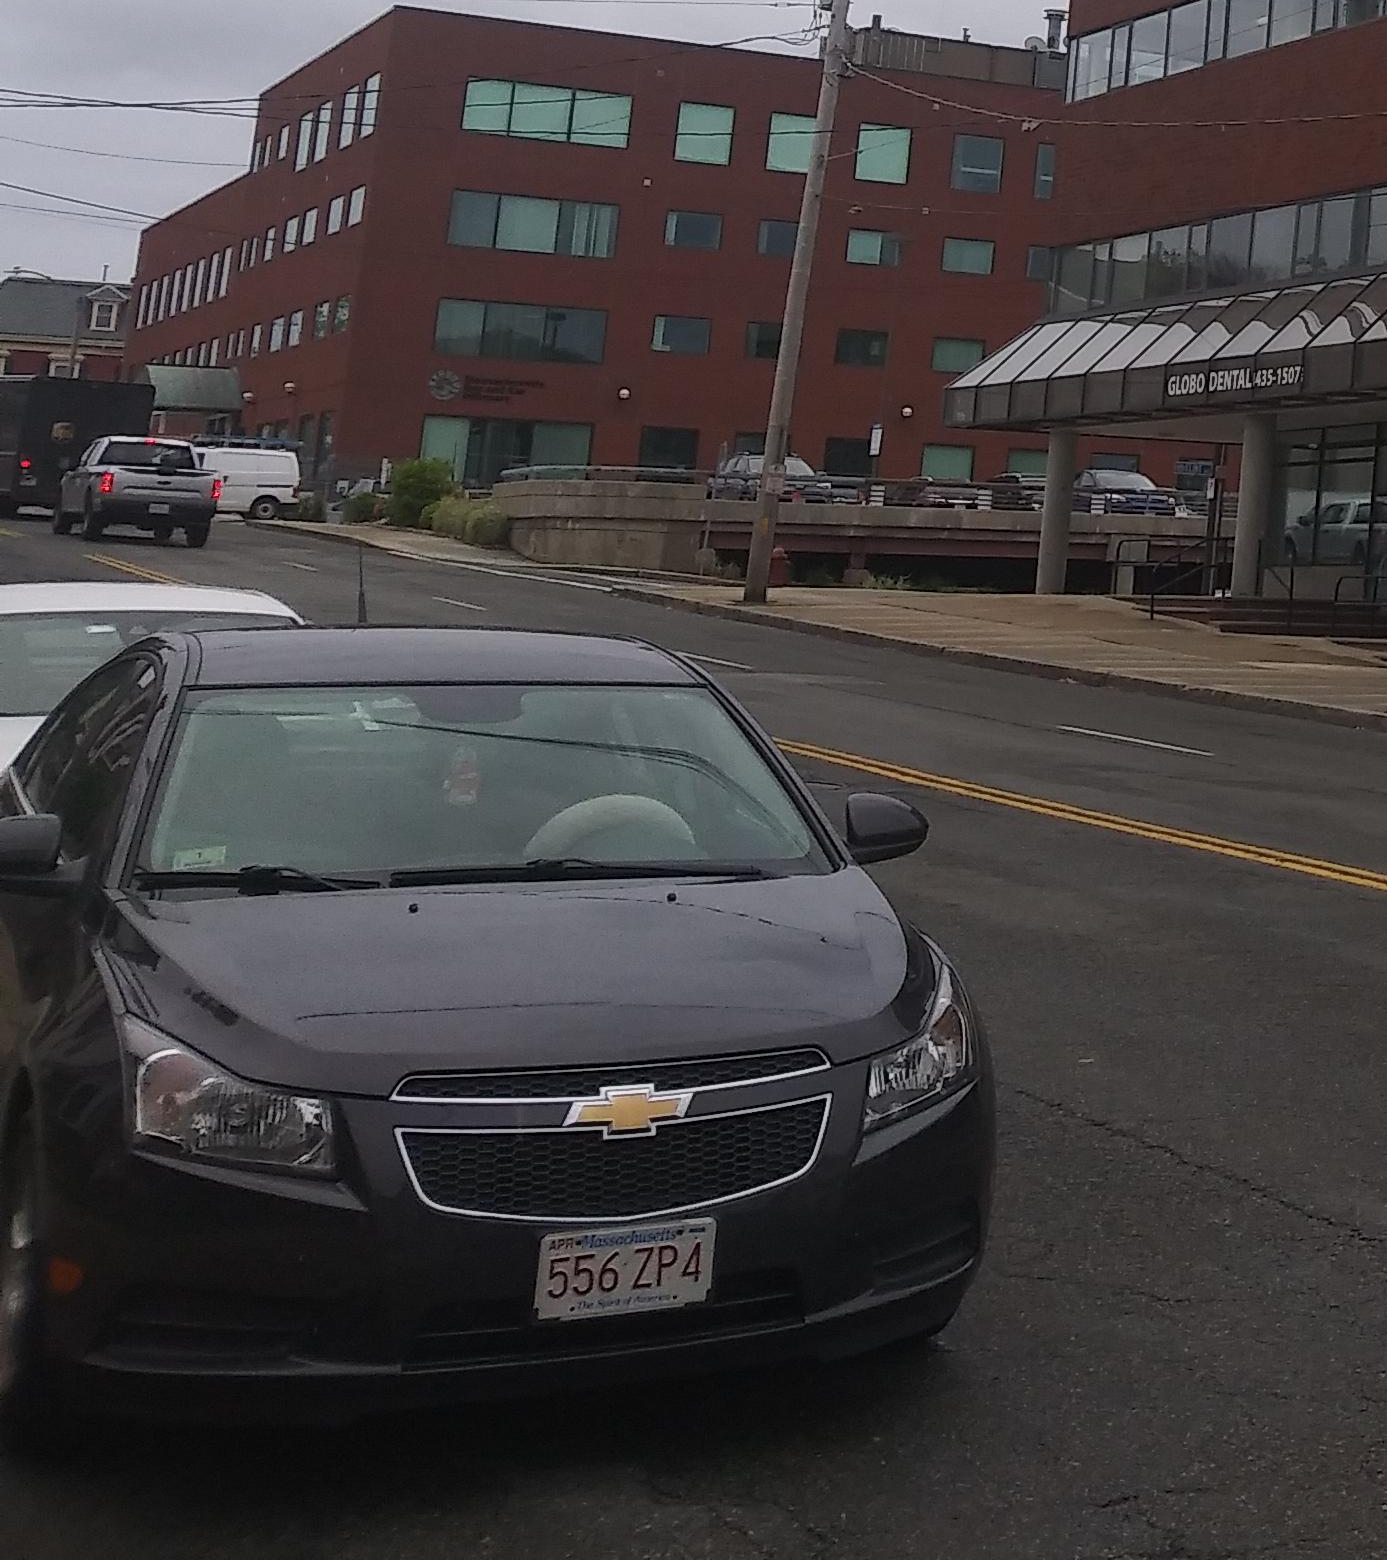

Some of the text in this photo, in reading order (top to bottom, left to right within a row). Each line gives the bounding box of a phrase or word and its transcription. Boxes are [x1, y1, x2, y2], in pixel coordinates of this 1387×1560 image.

[1167, 364, 1302, 397] GLOBO DENTAL 435-1507
[549, 1227, 677, 1251] APR Massachusetts
[548, 1240, 702, 1299] 556 ZP4
